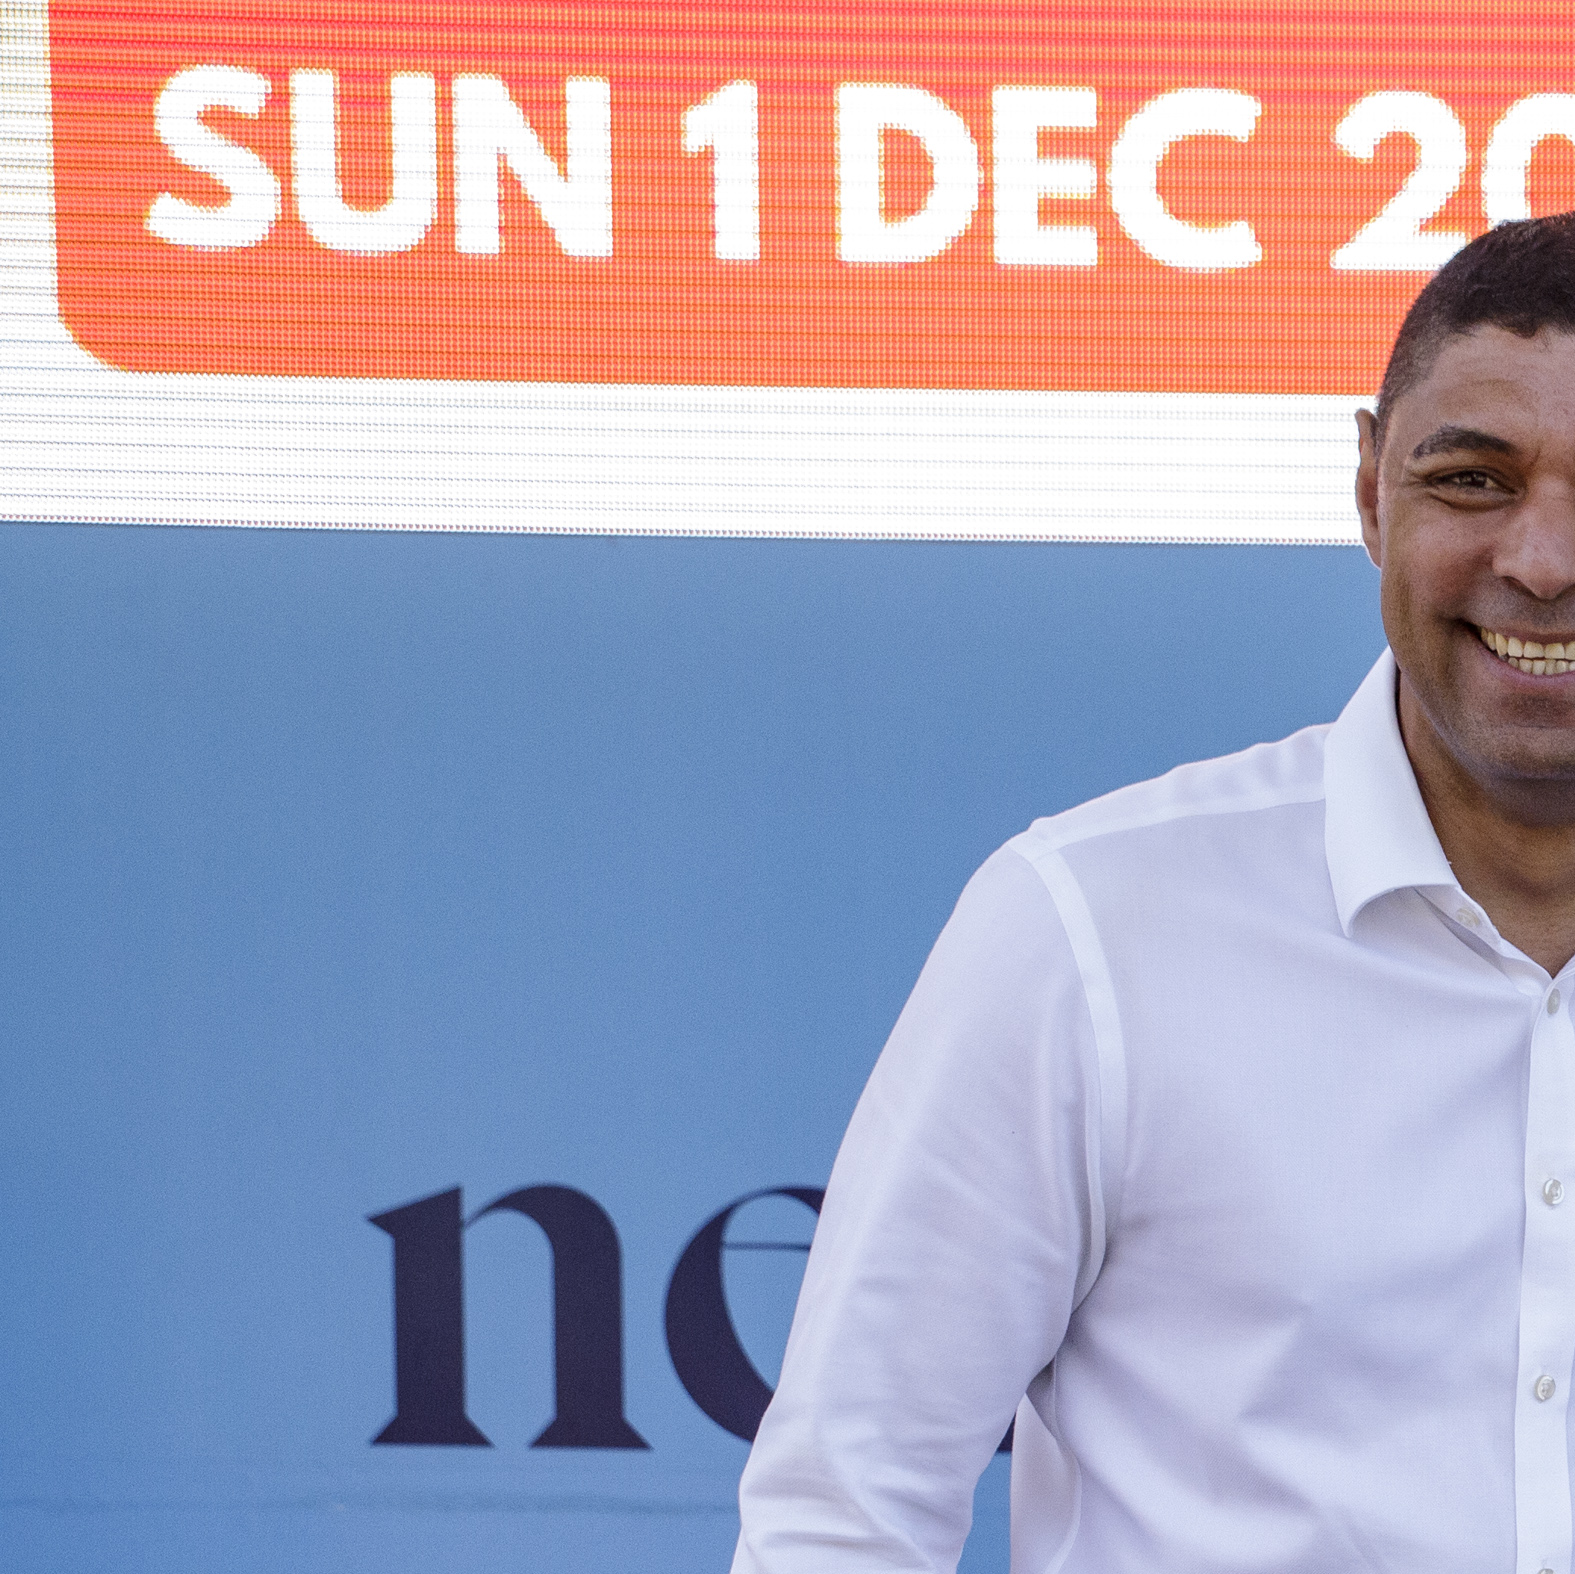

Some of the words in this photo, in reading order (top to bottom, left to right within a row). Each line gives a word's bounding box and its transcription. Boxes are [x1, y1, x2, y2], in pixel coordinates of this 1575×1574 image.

[144, 64, 614, 260] SUN
[681, 77, 761, 265] 1
[835, 81, 1265, 275] DEC
